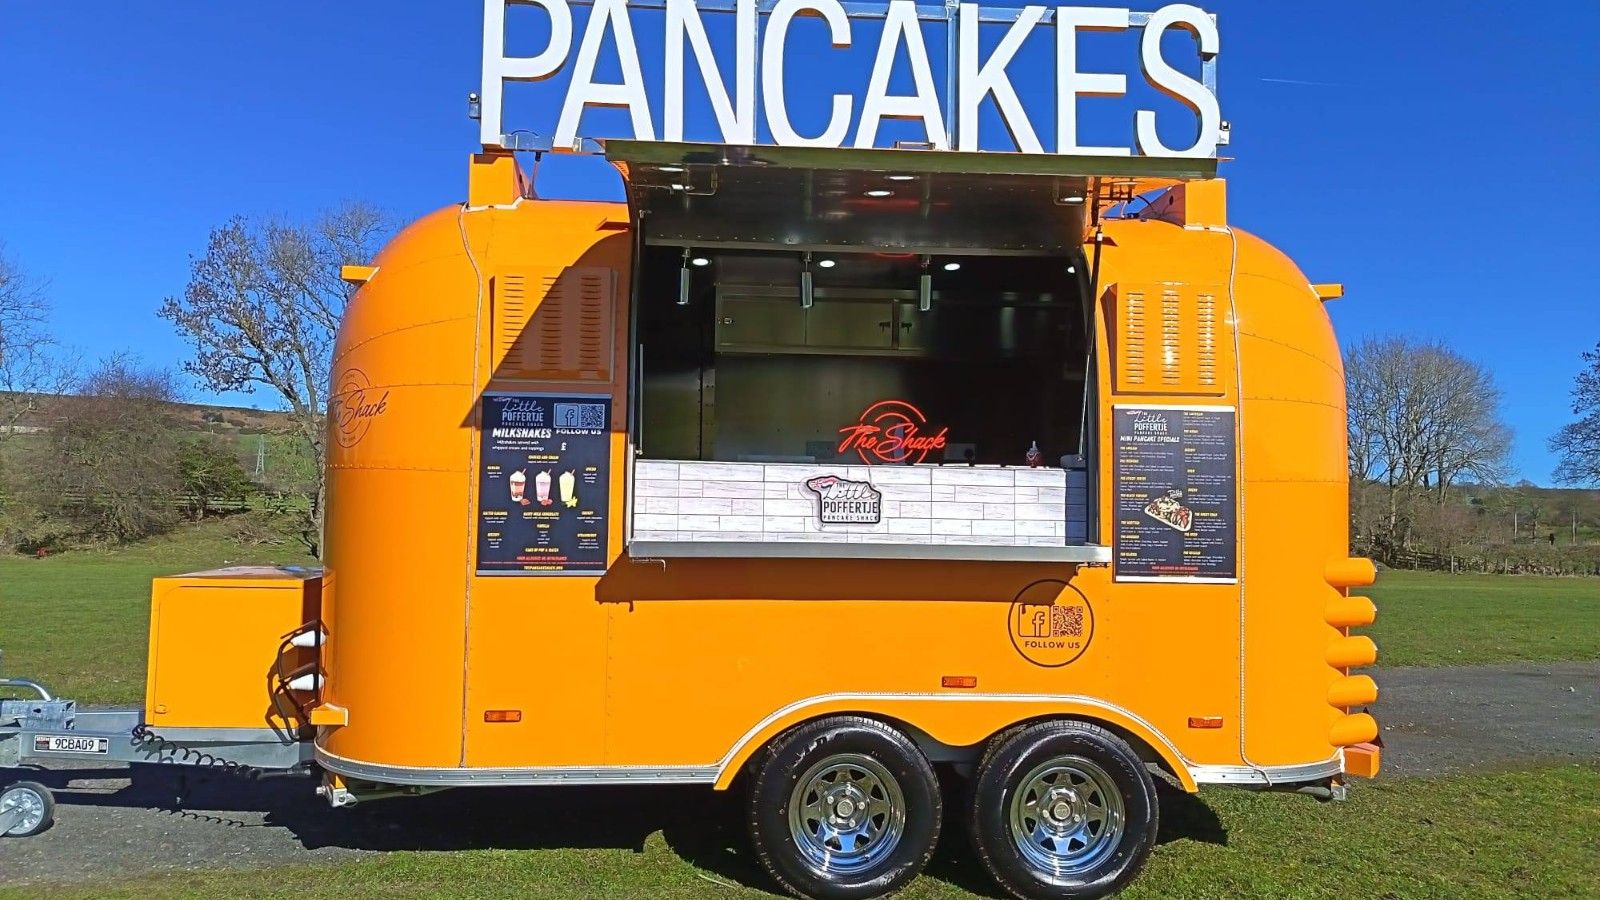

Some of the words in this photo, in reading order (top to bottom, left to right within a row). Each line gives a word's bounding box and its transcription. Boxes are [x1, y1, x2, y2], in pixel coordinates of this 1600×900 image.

[480, 0, 1219, 158] PANCAKES
[340, 390, 388, 427] Shack
[501, 397, 545, 412] Little
[502, 412, 544, 422] POFFERTJE
[1134, 410, 1168, 423] Little
[1134, 422, 1168, 431] POFFERTJE
[492, 428, 552, 439] MILKSHAKES
[556, 428, 589, 436] FOLLOW
[590, 428, 602, 436] US
[839, 423, 881, 453] The
[876, 422, 949, 454] Shack
[561, 442, 567, 451] £
[823, 482, 878, 500] Little
[823, 501, 878, 514] POFFERTJE
[1025, 641, 1065, 649] FOLLOW
[1068, 641, 1081, 649] US
